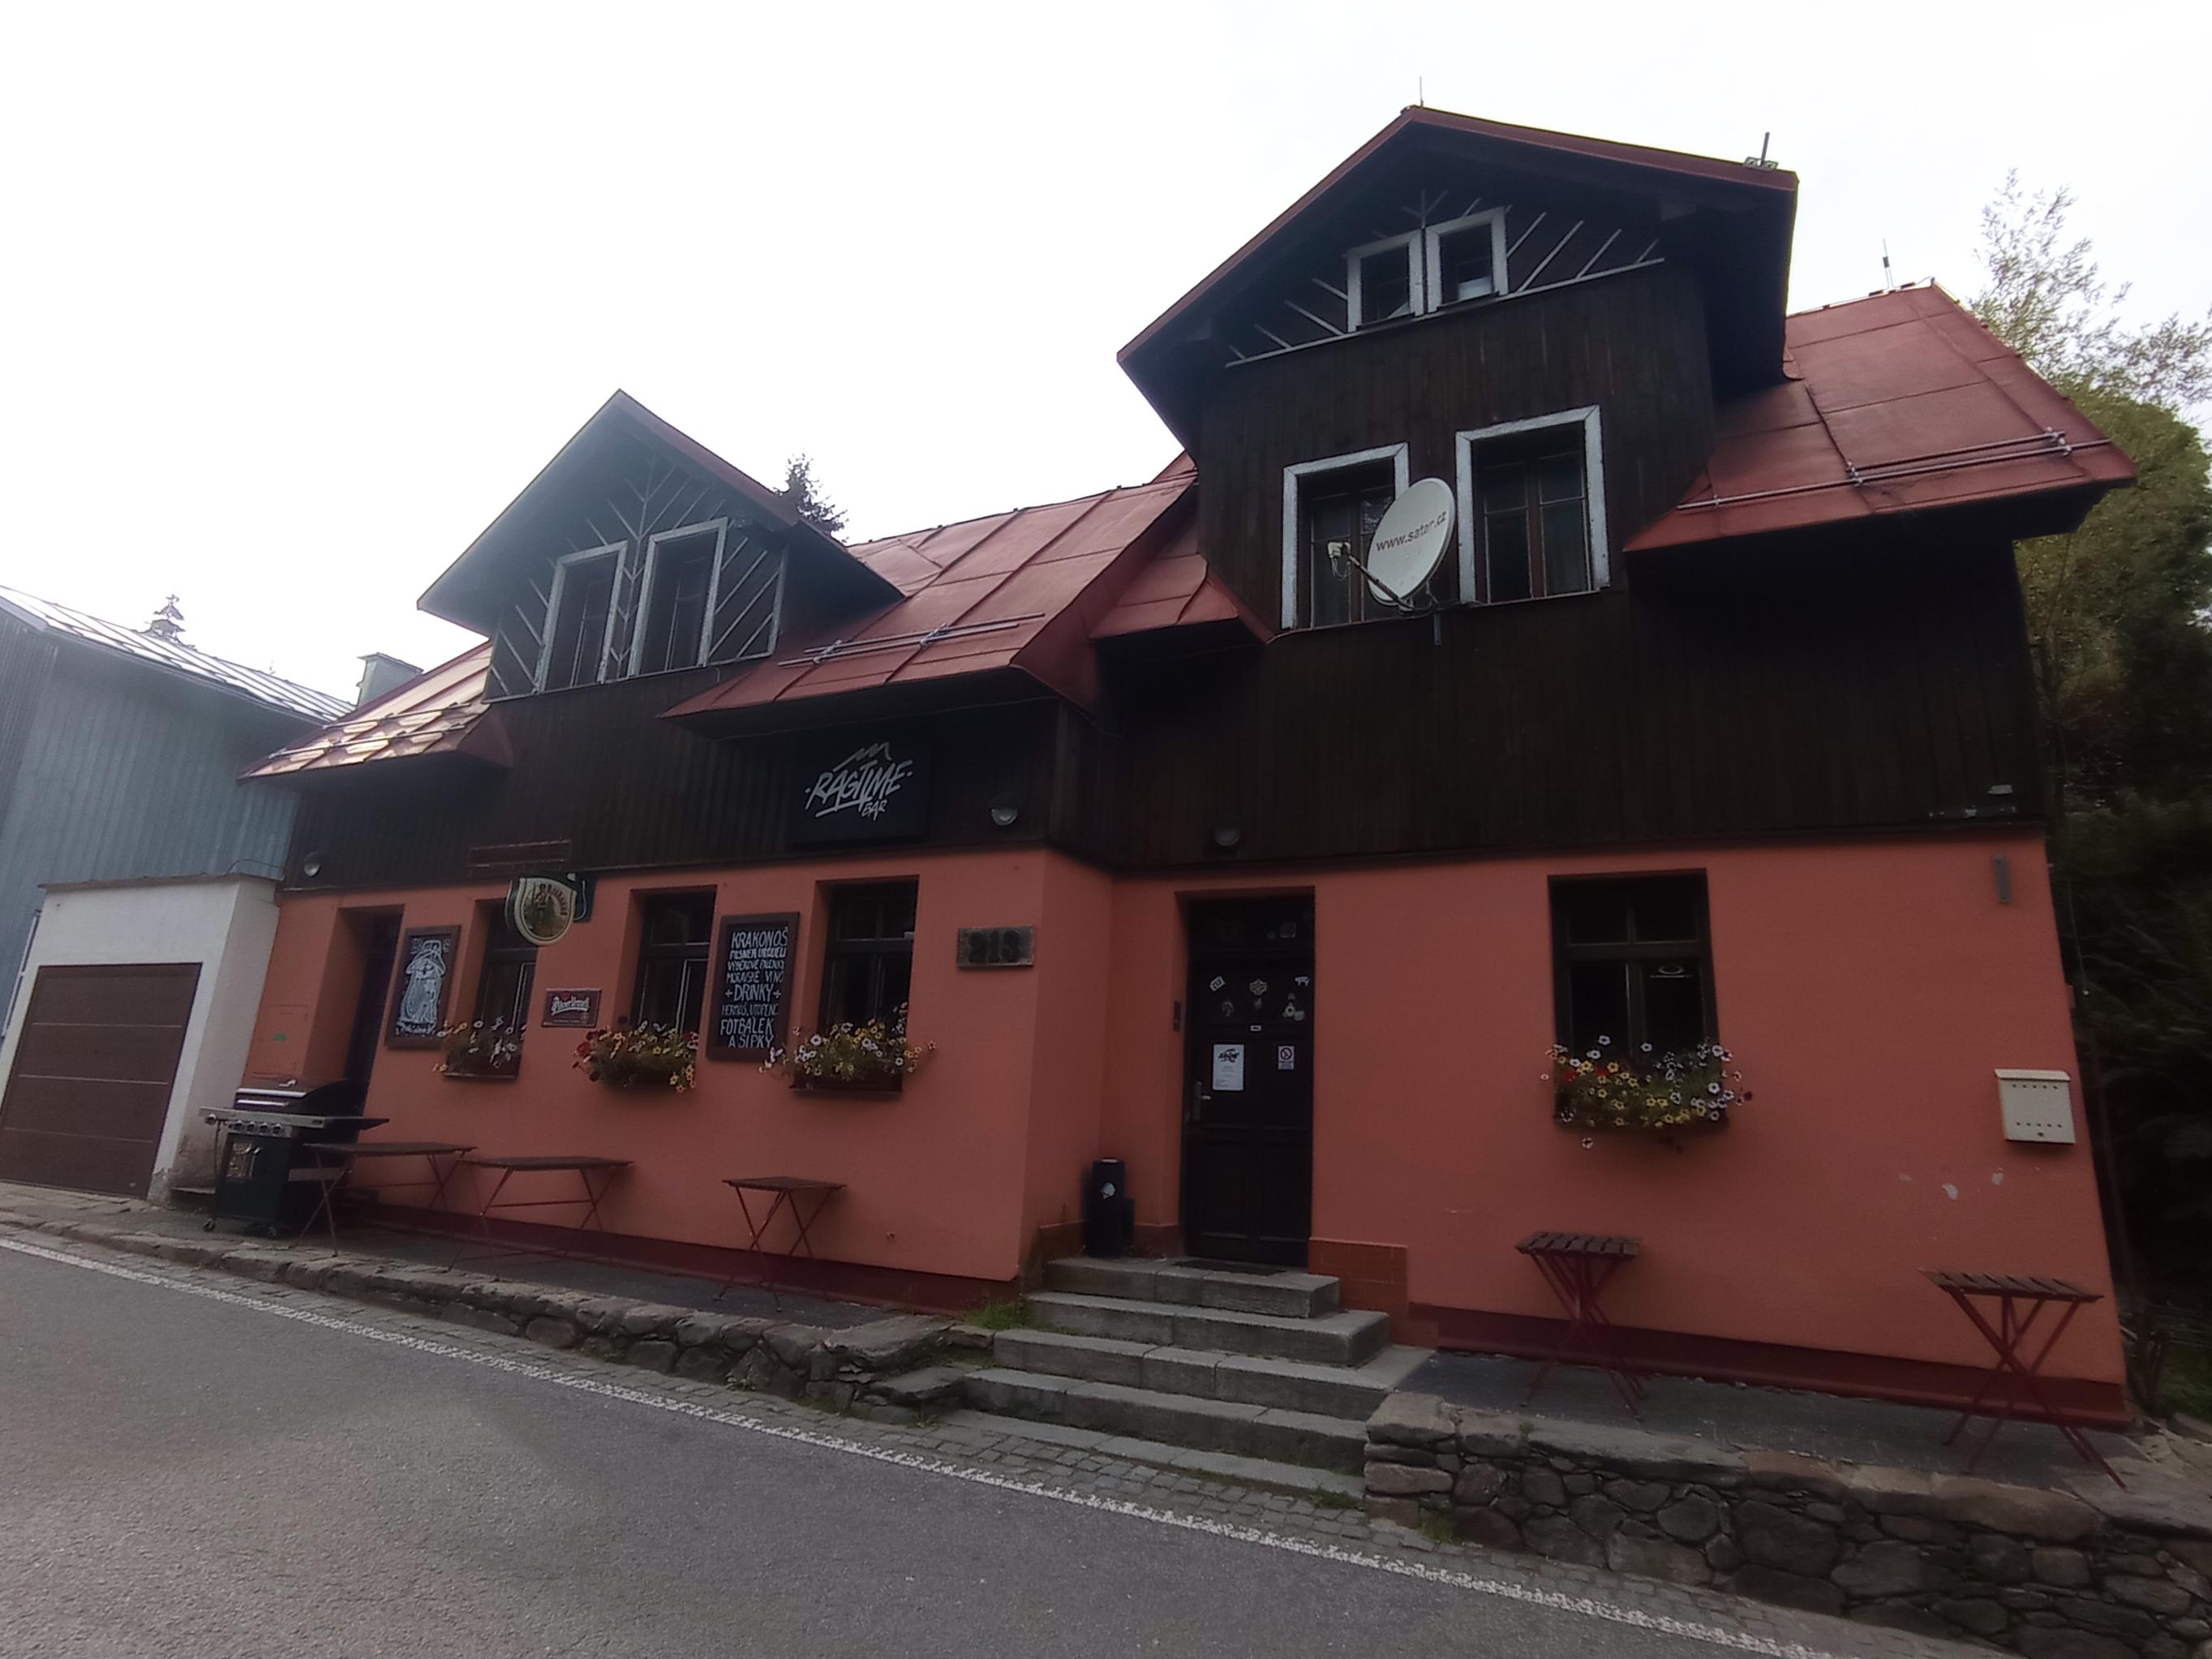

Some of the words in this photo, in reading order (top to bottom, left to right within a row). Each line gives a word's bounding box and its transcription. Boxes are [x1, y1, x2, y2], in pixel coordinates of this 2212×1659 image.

[805, 757, 913, 812] RAGTIME
[731, 926, 789, 948] KRAKONOŠ
[728, 1035, 736, 1048] A
